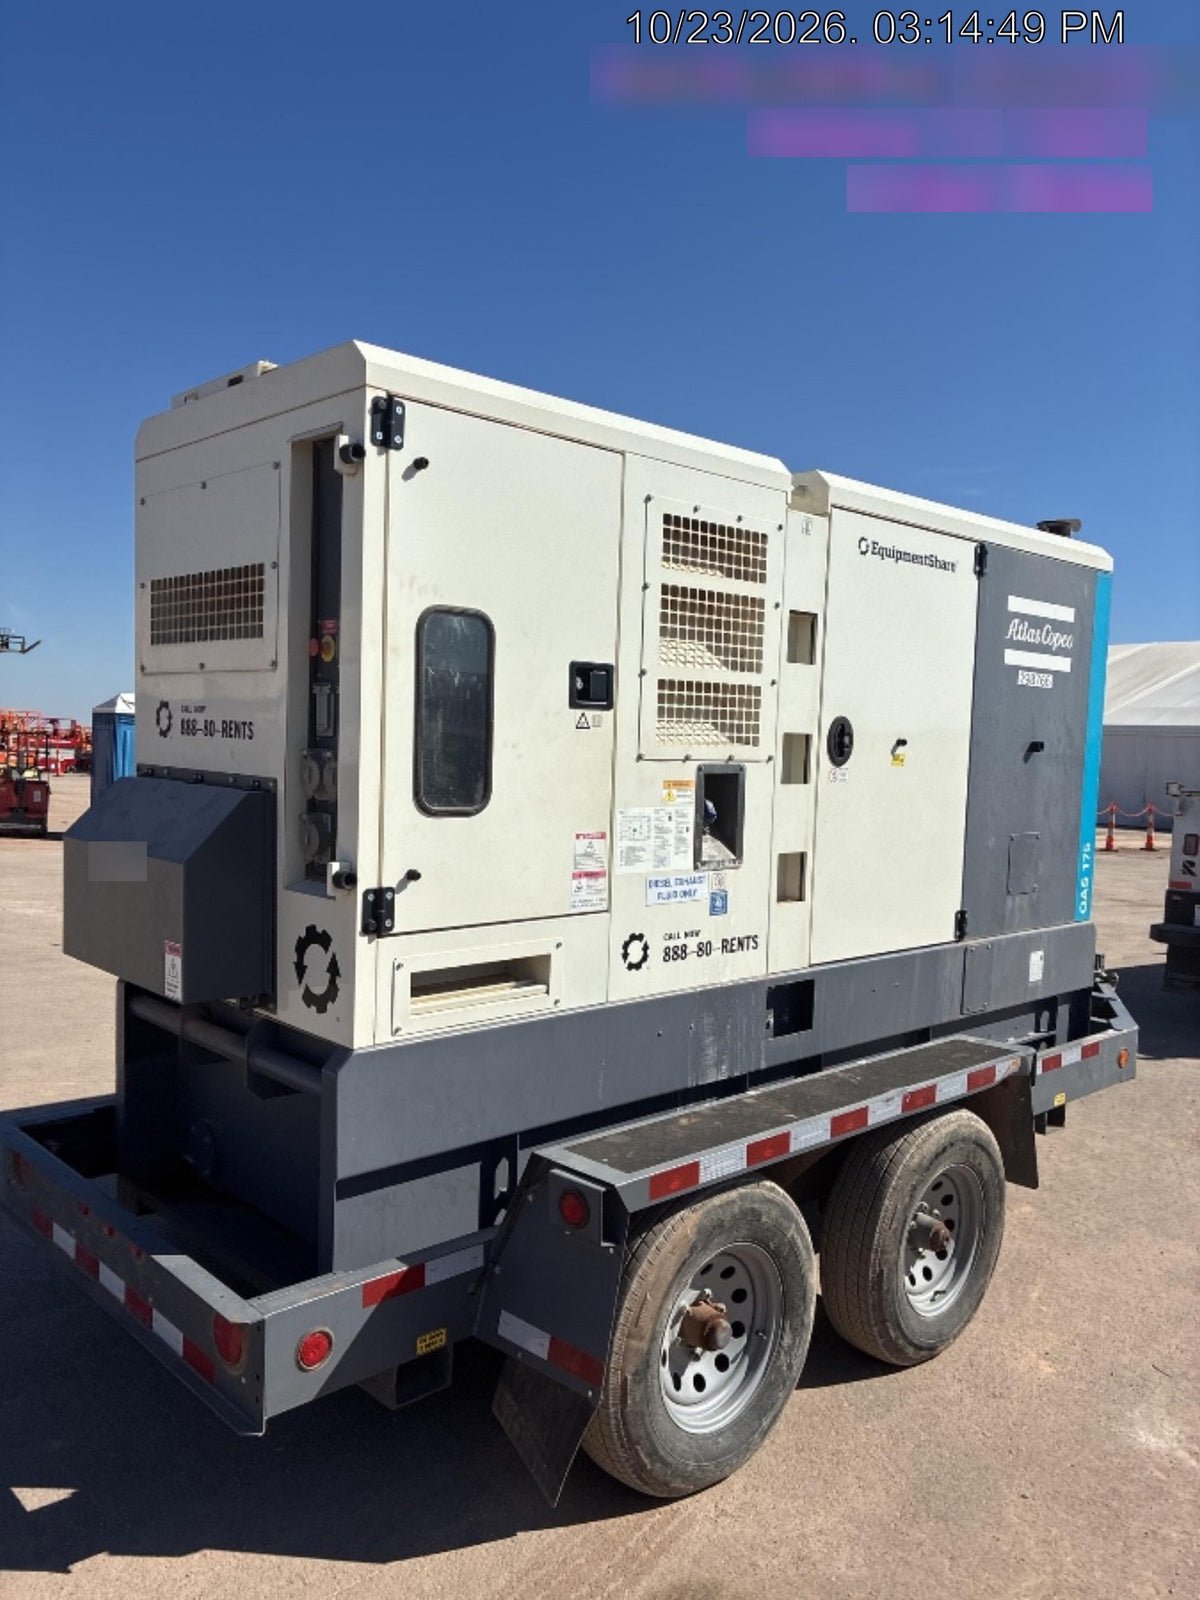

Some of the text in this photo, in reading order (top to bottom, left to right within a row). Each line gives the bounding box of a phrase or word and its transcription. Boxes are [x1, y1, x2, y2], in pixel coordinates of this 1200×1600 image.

[871, 540, 956, 573] EquipmentShare
[1004, 618, 1074, 651] Atlas Copco
[180, 718, 254, 740] 888-80-RENTS
[662, 934, 759, 963] 888-80-RENTS
